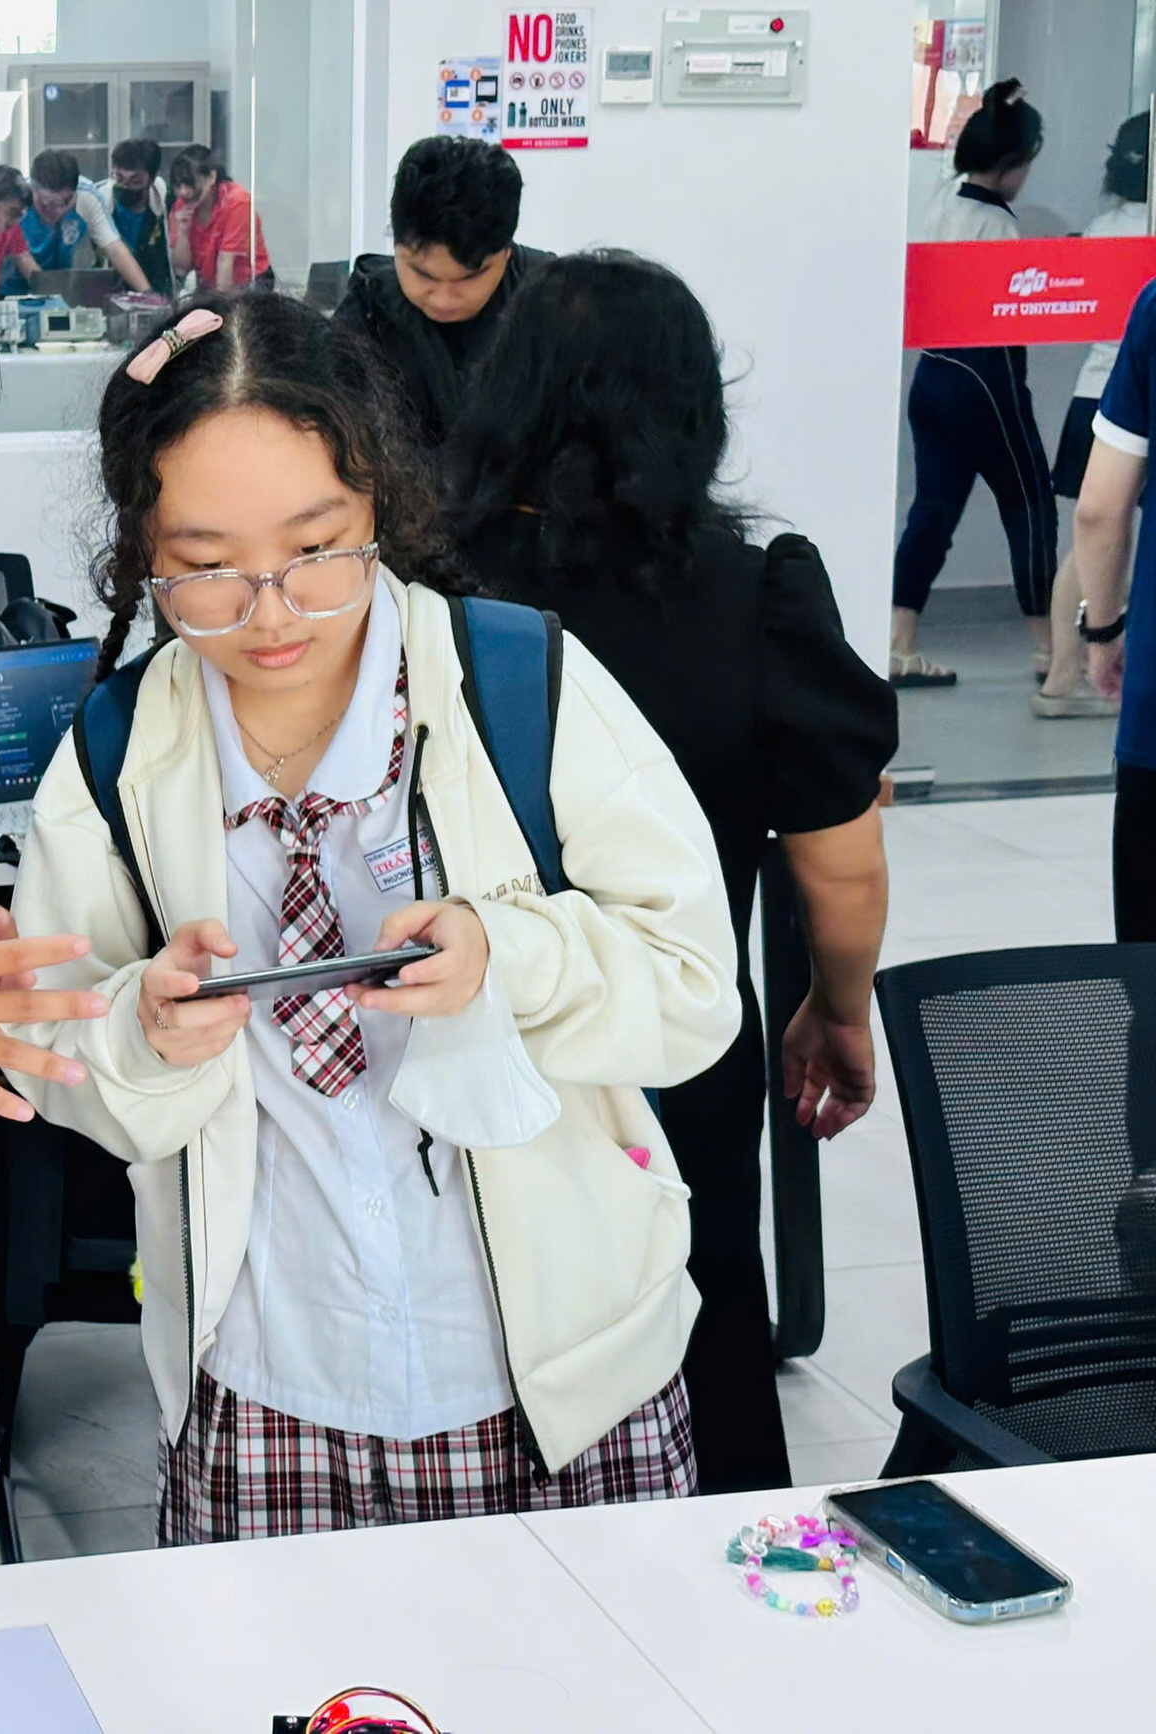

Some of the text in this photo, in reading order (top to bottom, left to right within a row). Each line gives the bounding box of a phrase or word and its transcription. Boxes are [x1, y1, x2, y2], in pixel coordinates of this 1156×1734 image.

[556, 13, 576, 24] FOOD
[508, 13, 552, 62] NO
[555, 26, 584, 37] DRINKS
[554, 39, 587, 50] PHONES
[554, 51, 587, 63] JOKERS
[540, 98, 574, 116] ONLY
[529, 116, 585, 128] BOTTLED WATER
[992, 301, 1099, 316] FPT UNIVERSITY
